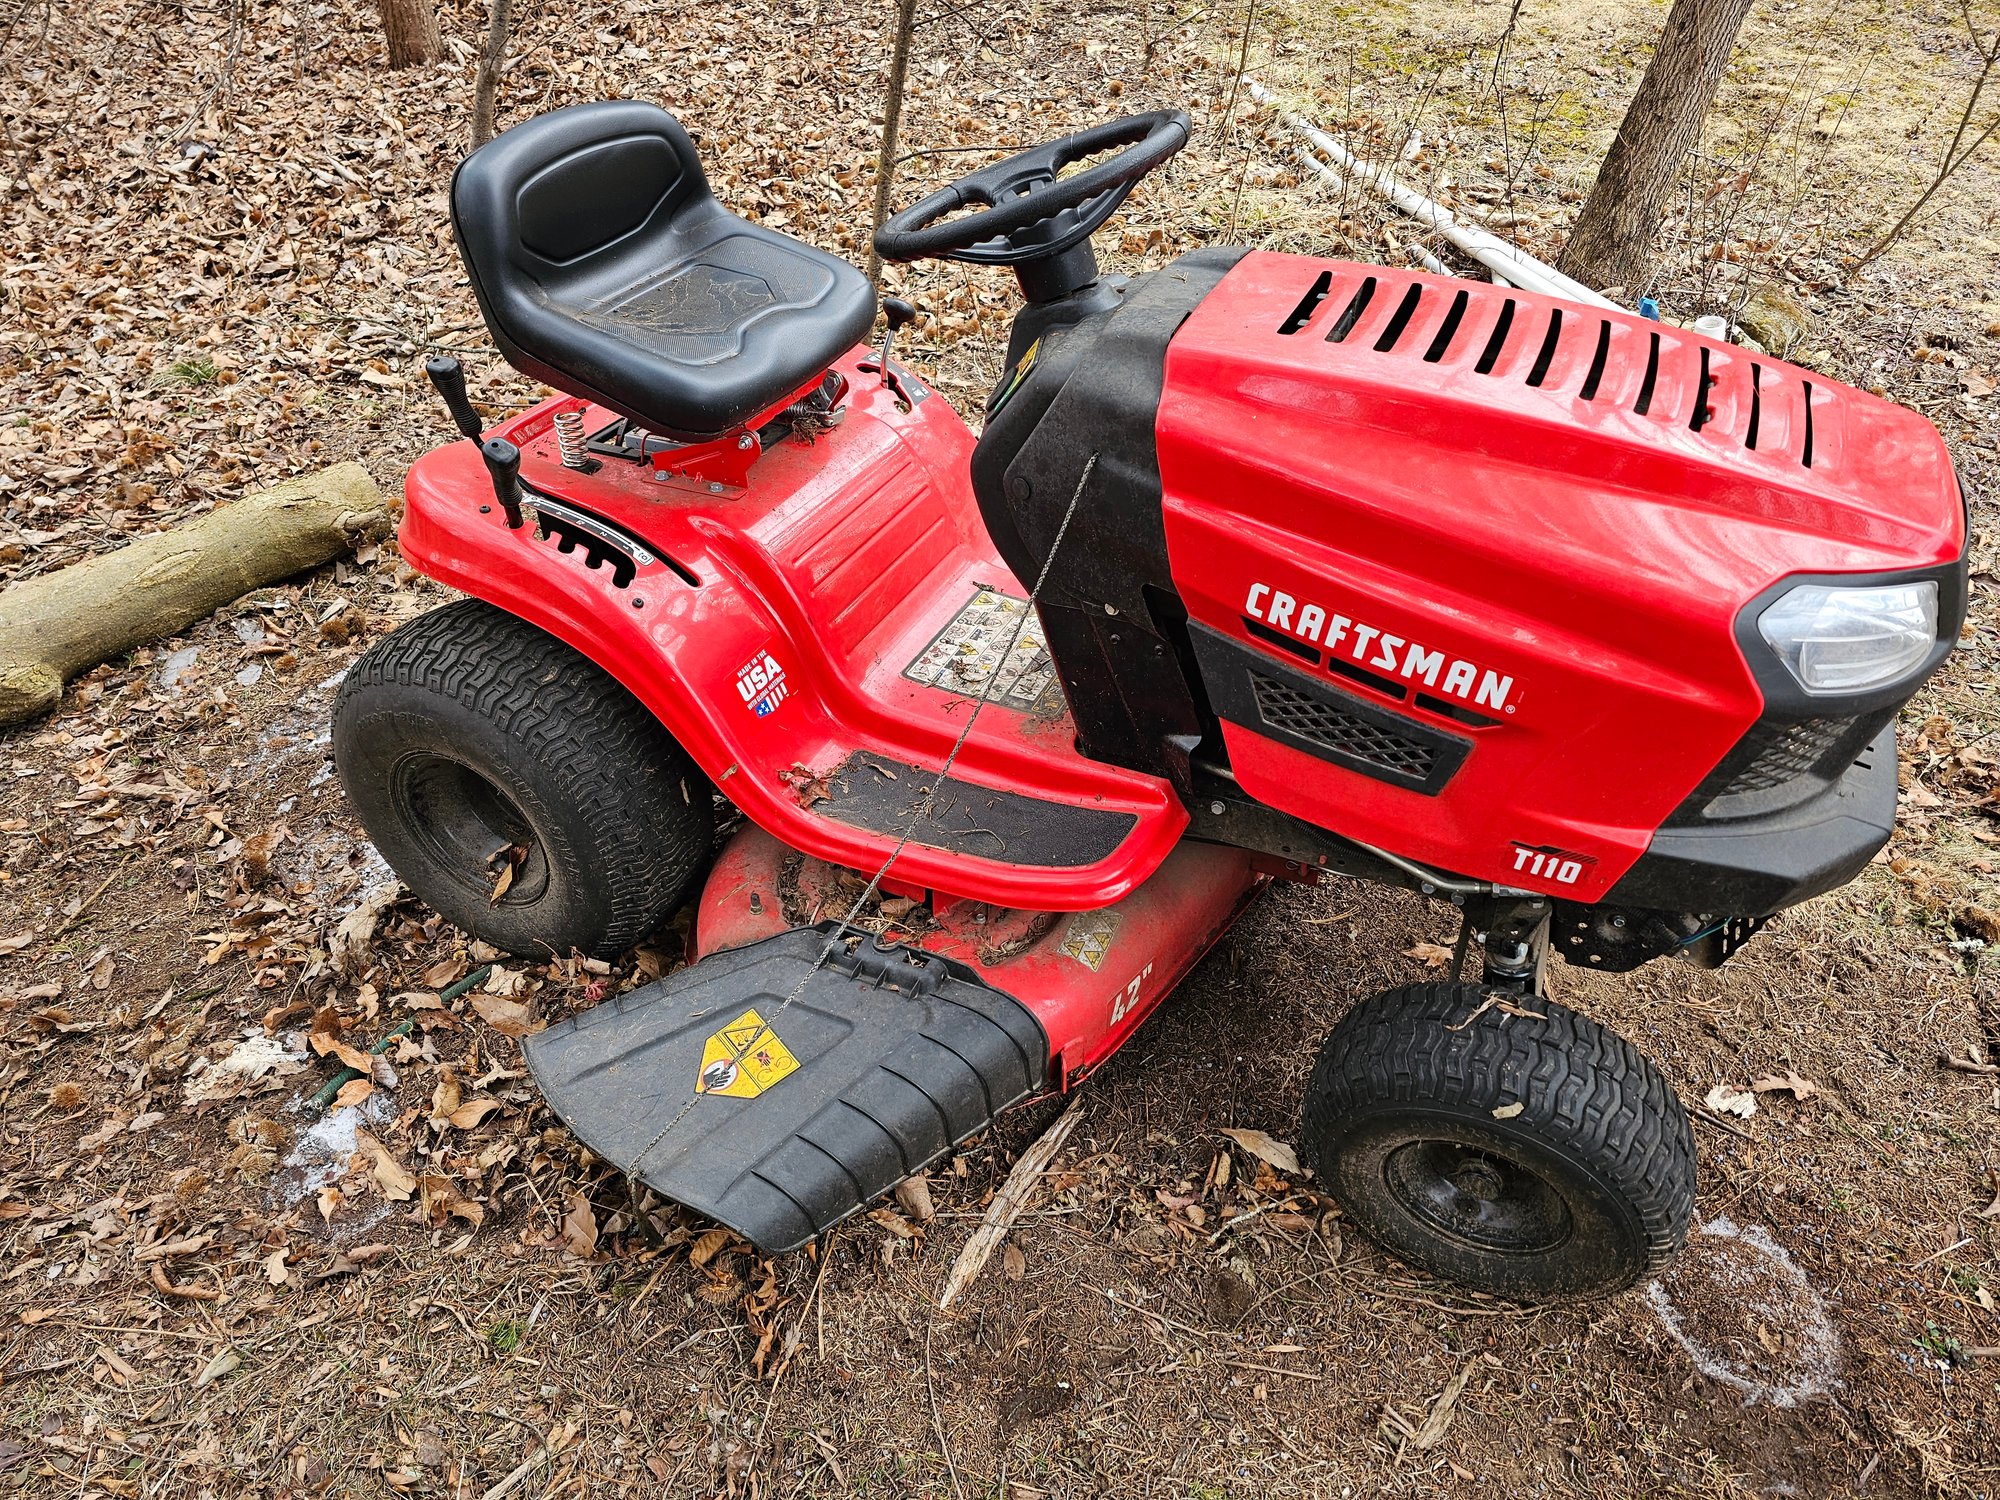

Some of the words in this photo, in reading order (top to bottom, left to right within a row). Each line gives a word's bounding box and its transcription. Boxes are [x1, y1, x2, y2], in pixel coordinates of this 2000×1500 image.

[736, 655, 782, 702] USA
[737, 662, 752, 678] MADE
[751, 657, 758, 666] IN
[1513, 848, 1582, 884] T110
[1109, 962, 1153, 1026] 42"
